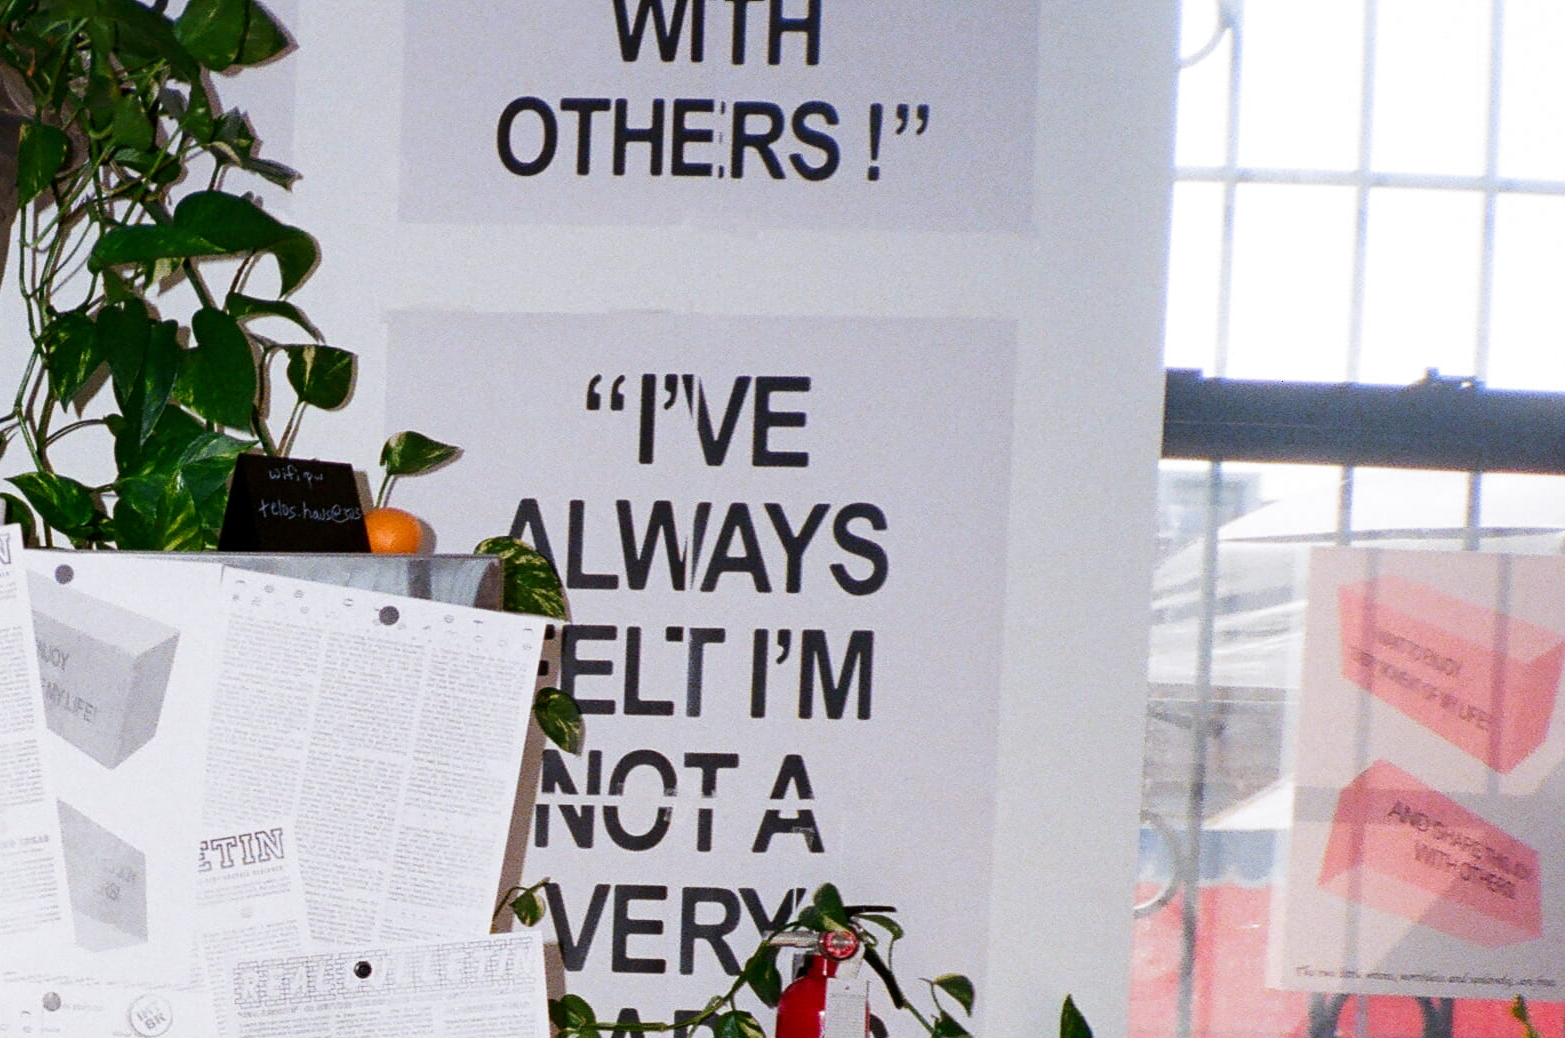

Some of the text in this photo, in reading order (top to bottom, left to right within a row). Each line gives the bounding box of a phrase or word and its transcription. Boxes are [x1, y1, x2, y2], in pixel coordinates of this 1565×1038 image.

[612, 0, 821, 66] WITH
[508, 498, 890, 596] ALWAYS
[535, 749, 825, 854] NOT A
[545, 883, 807, 976] VERY
